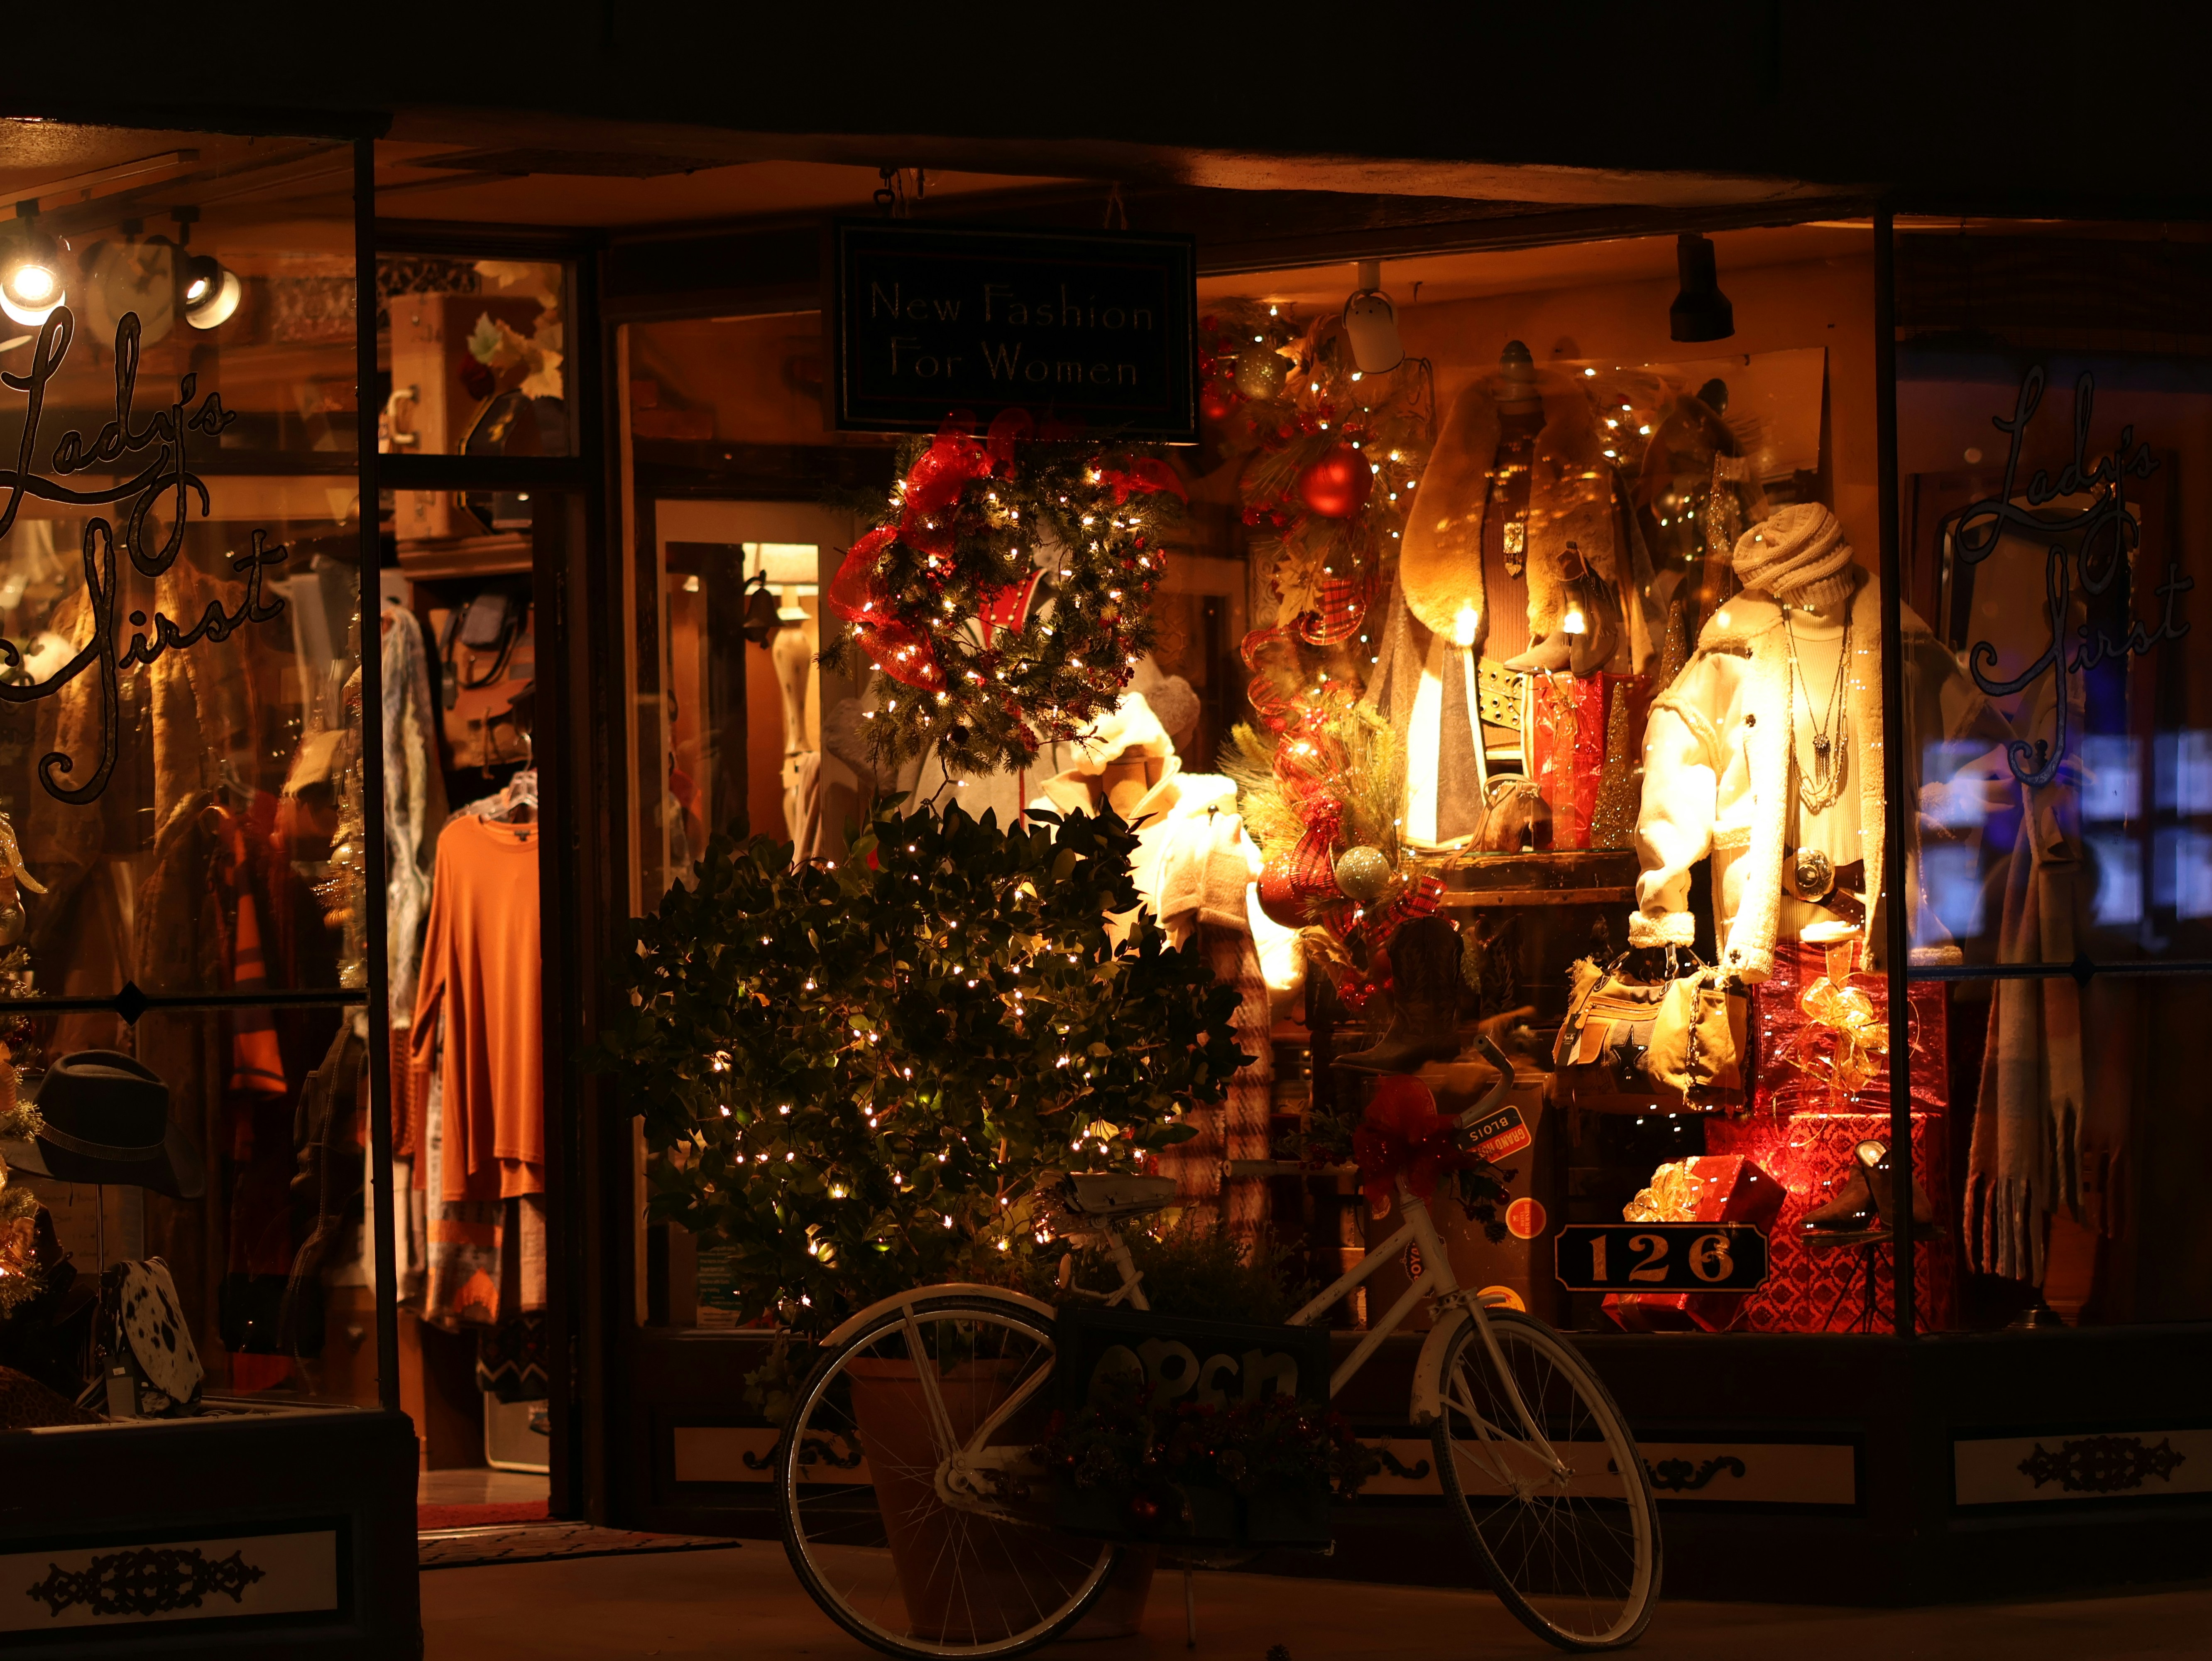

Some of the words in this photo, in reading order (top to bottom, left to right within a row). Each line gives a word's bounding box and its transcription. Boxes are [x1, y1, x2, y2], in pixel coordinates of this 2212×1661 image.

[870, 281, 961, 322] New
[984, 281, 1153, 331] Fashion
[891, 336, 962, 378] For
[980, 341, 1138, 385] Women
[0, 306, 236, 577] Lady's
[1955, 365, 2161, 596] Lady's
[1469, 1116, 1509, 1141] BLOIS
[1495, 1128, 1525, 1150] GRAND
[1588, 1233, 1734, 1282] 126
